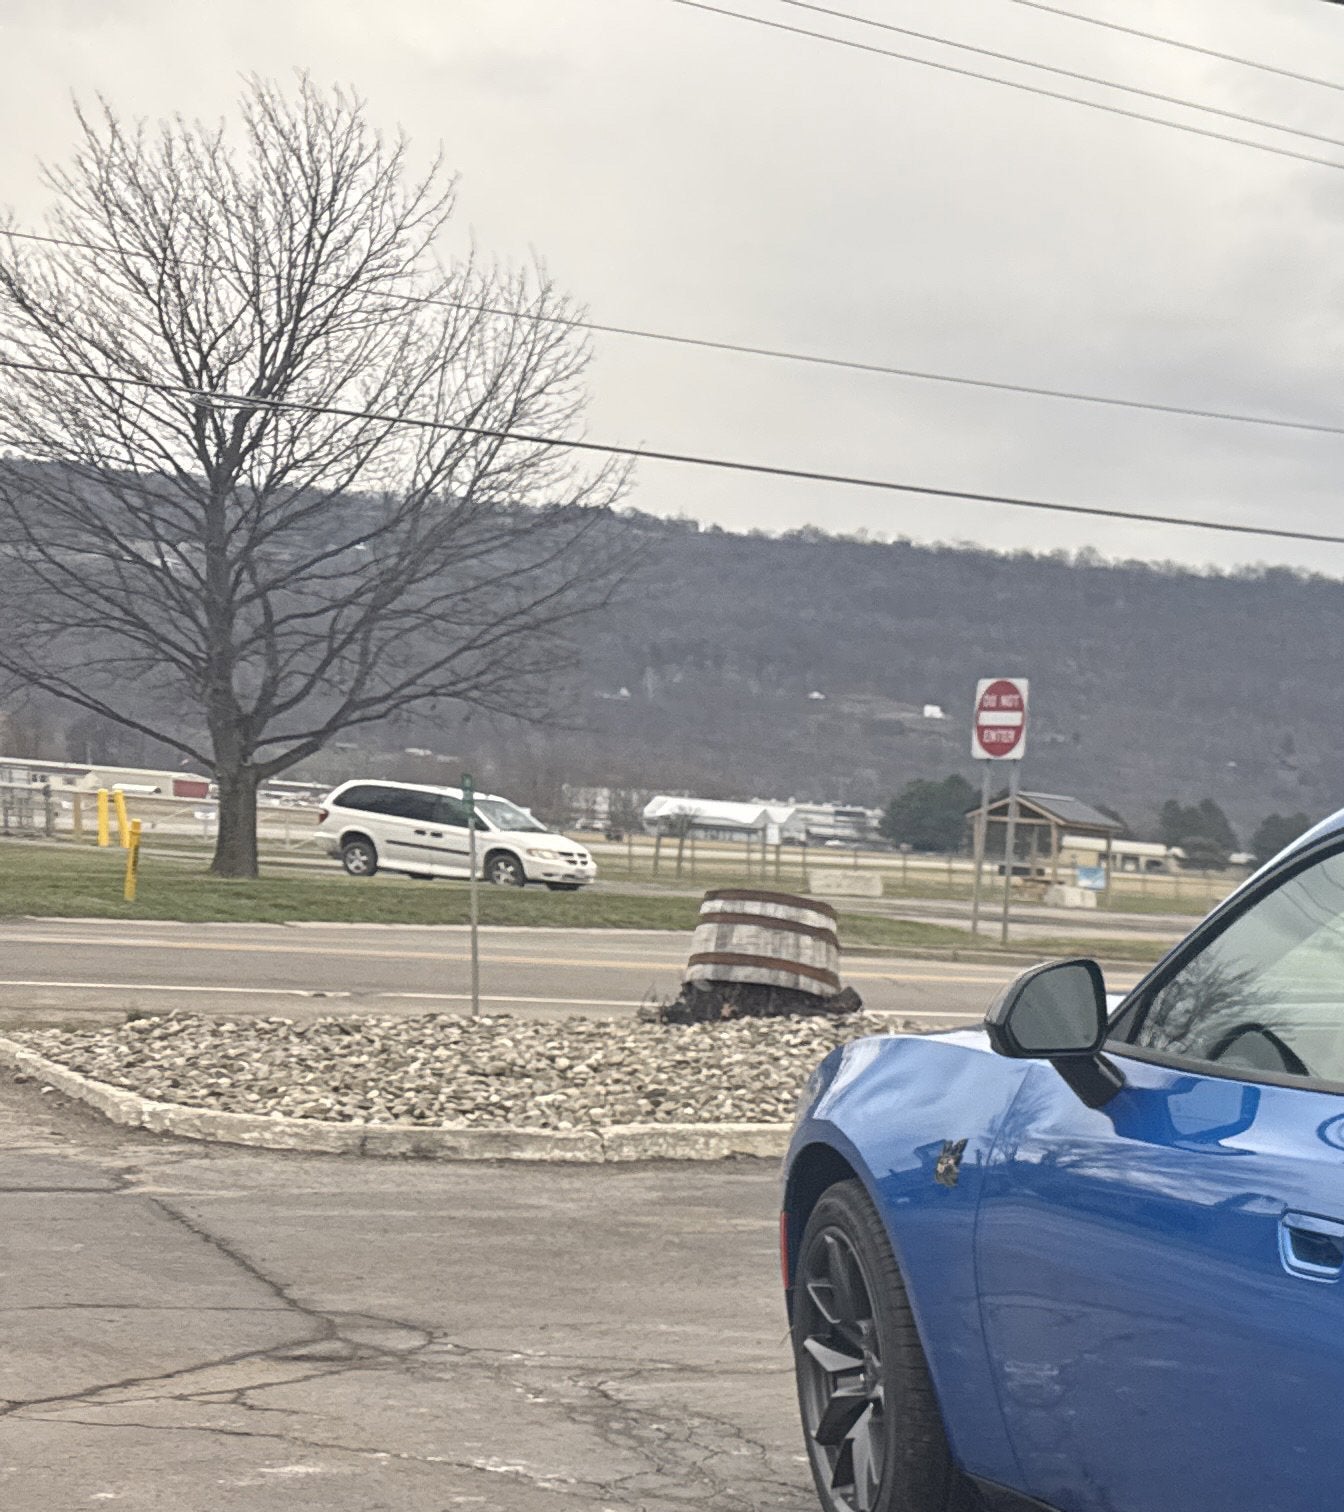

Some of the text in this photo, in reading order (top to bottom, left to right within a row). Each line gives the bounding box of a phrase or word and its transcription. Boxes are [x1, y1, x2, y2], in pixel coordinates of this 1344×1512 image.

[982, 694, 1020, 708] DO NOT
[983, 729, 1016, 743] ENTER
